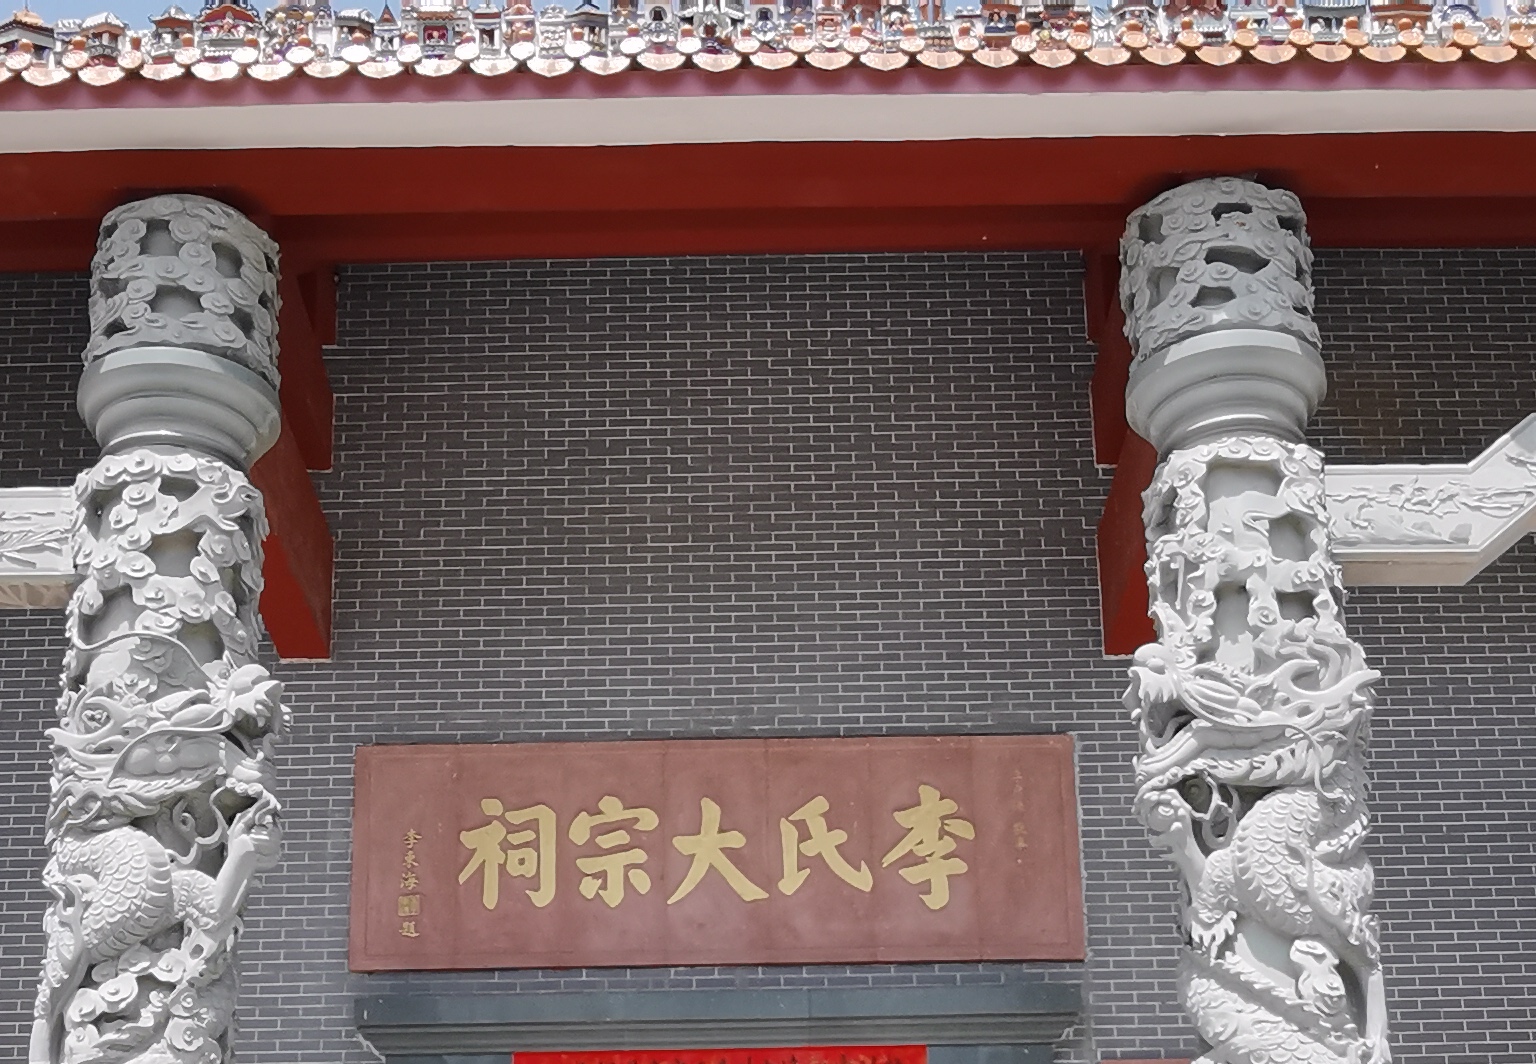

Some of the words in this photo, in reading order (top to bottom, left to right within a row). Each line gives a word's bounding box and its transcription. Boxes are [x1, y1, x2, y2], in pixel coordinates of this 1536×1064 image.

[457, 784, 976, 911] 李氏大宗祠
